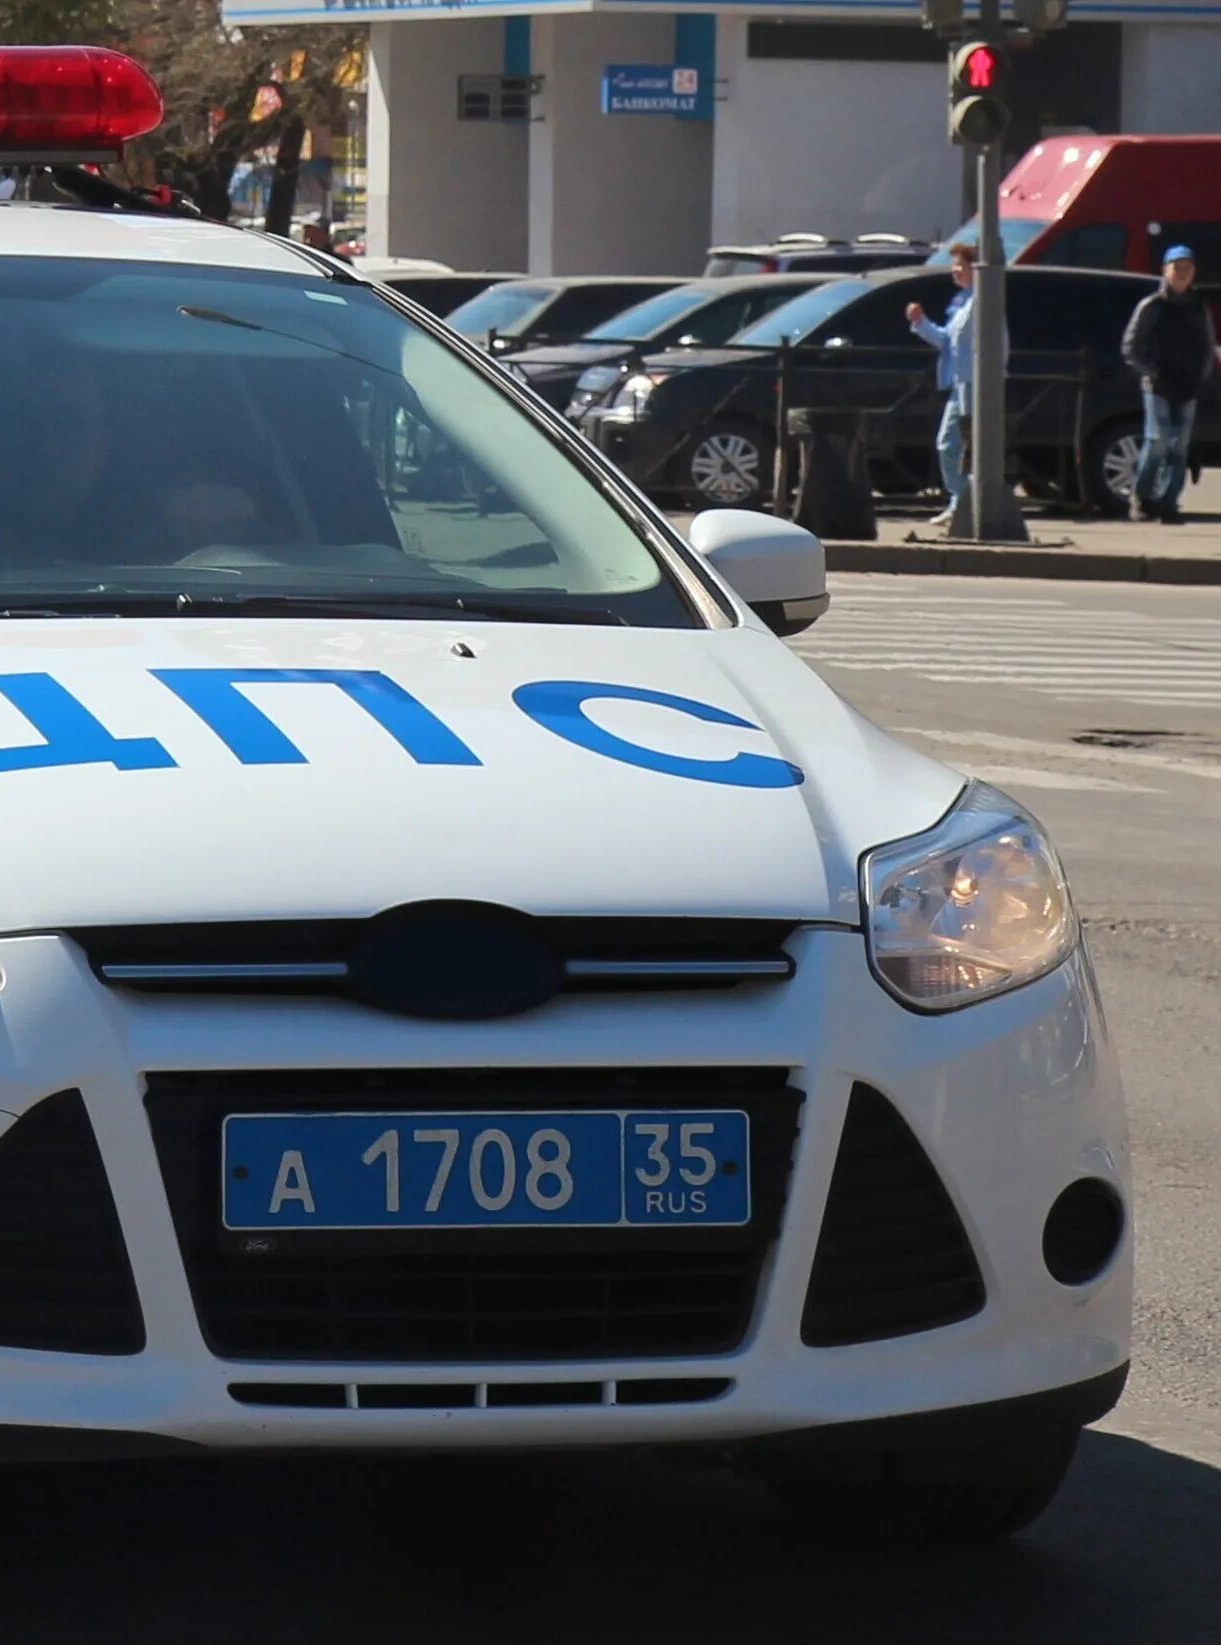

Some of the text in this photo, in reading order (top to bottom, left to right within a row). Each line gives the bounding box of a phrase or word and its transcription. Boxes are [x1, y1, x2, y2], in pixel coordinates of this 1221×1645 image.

[612, 97, 696, 110] БАНКОМАТ
[268, 1123, 717, 1213] А 1708 35
[646, 1191, 707, 1213] RUS
